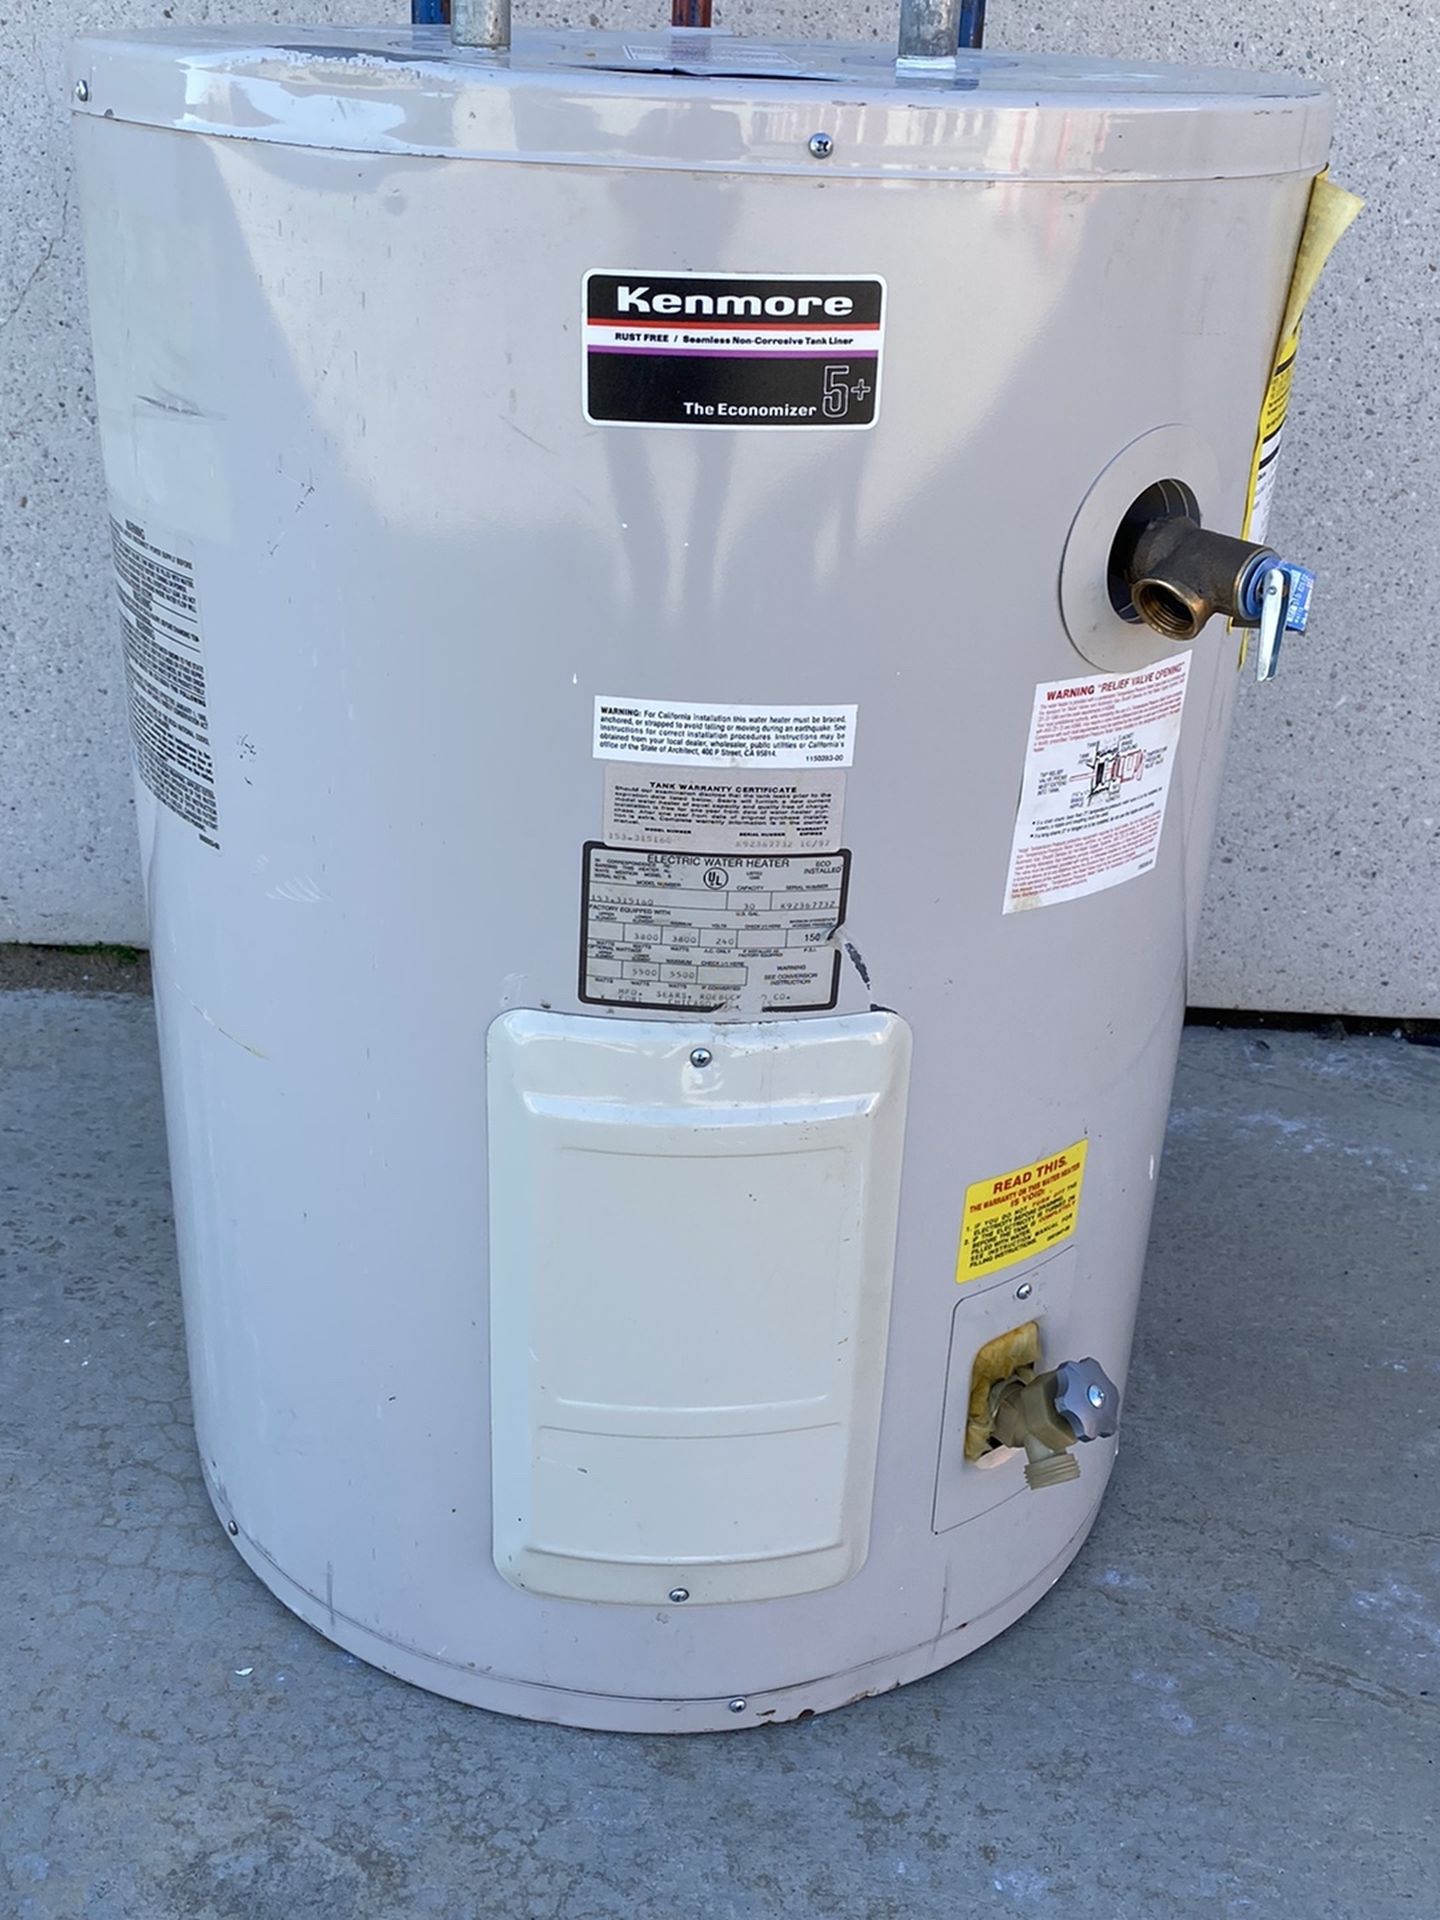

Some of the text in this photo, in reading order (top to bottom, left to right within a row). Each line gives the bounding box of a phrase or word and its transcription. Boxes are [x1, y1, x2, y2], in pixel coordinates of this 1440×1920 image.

[616, 286, 853, 316] Kenmore
[615, 333, 642, 342] RUST
[644, 333, 669, 343] FREE
[683, 335, 731, 344] Seamless
[732, 336, 804, 345] Non-Corrosive
[805, 337, 828, 345] Tank
[828, 337, 853, 345] Liner
[683, 402, 715, 416] The
[717, 403, 817, 417] Economizer
[1047, 685, 1095, 701] WARNING
[1132, 672, 1153, 686] VALVE
[601, 706, 641, 717] WARNING:
[644, 710, 655, 718] For
[657, 711, 691, 721] California
[733, 715, 746, 723] this
[644, 719, 674, 729] strapped
[684, 722, 703, 730] avoid
[704, 723, 725, 732] falling
[735, 725, 760, 733] moving
[762, 725, 783, 733] during
[600, 732, 629, 741] obtained
[658, 729, 685, 737] correct
[836, 732, 846, 740] be
[620, 742, 627, 750] of
[628, 743, 639, 751] the
[640, 743, 657, 752] State
[659, 745, 667, 753] of
[744, 749, 754, 757] CA
[650, 782, 797, 794] TANK WARRANTY CERTIFICATE
[647, 854, 790, 868] ELECTRIC WATER HEATER
[804, 866, 842, 875] INSTALLED
[589, 904, 618, 912] FACTORY
[620, 906, 653, 914] EQUIPPED
[804, 934, 821, 942] 150
[993, 1172, 1032, 1194] READ
[1010, 1199, 1019, 1208] IS
